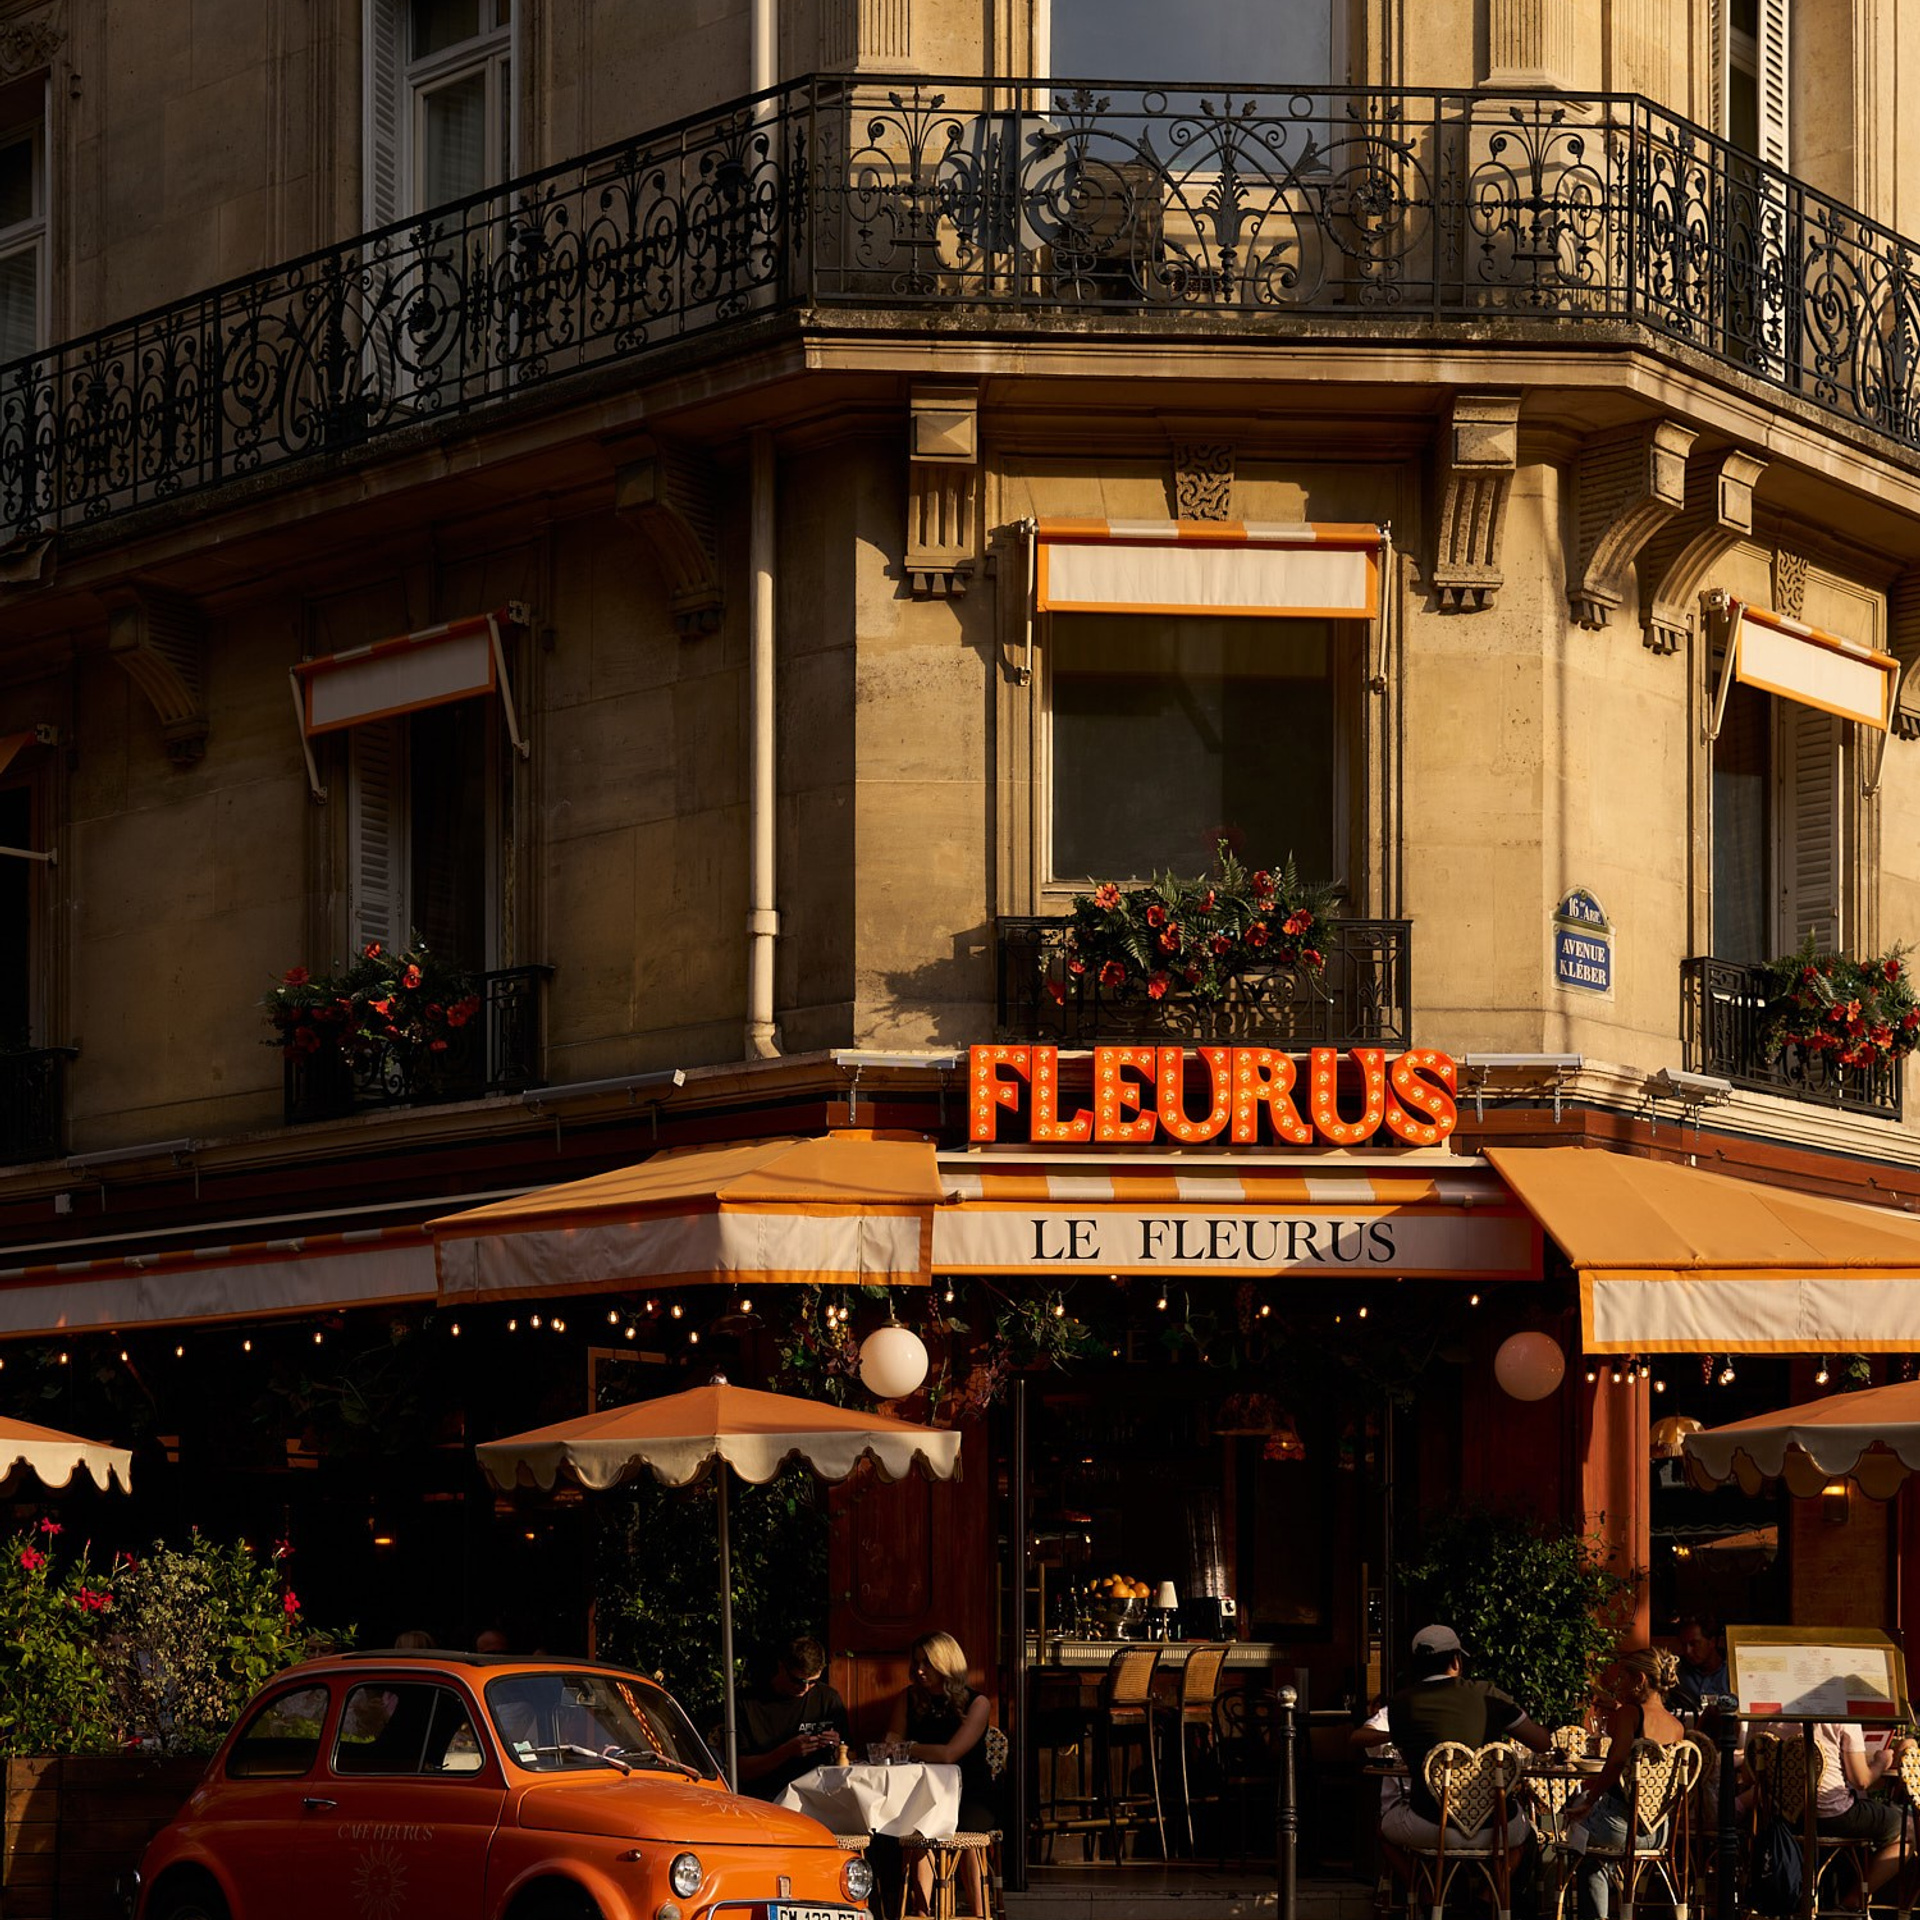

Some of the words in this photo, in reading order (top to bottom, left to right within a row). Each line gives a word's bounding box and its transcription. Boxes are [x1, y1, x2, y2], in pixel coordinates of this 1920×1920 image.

[1562, 938, 1605, 963] AVENUE
[1560, 959, 1606, 985] KLÉBER
[969, 1044, 1458, 1145] FLEURUS
[1030, 1218, 1101, 1261] LE
[1138, 1219, 1397, 1263] FLEURUS
